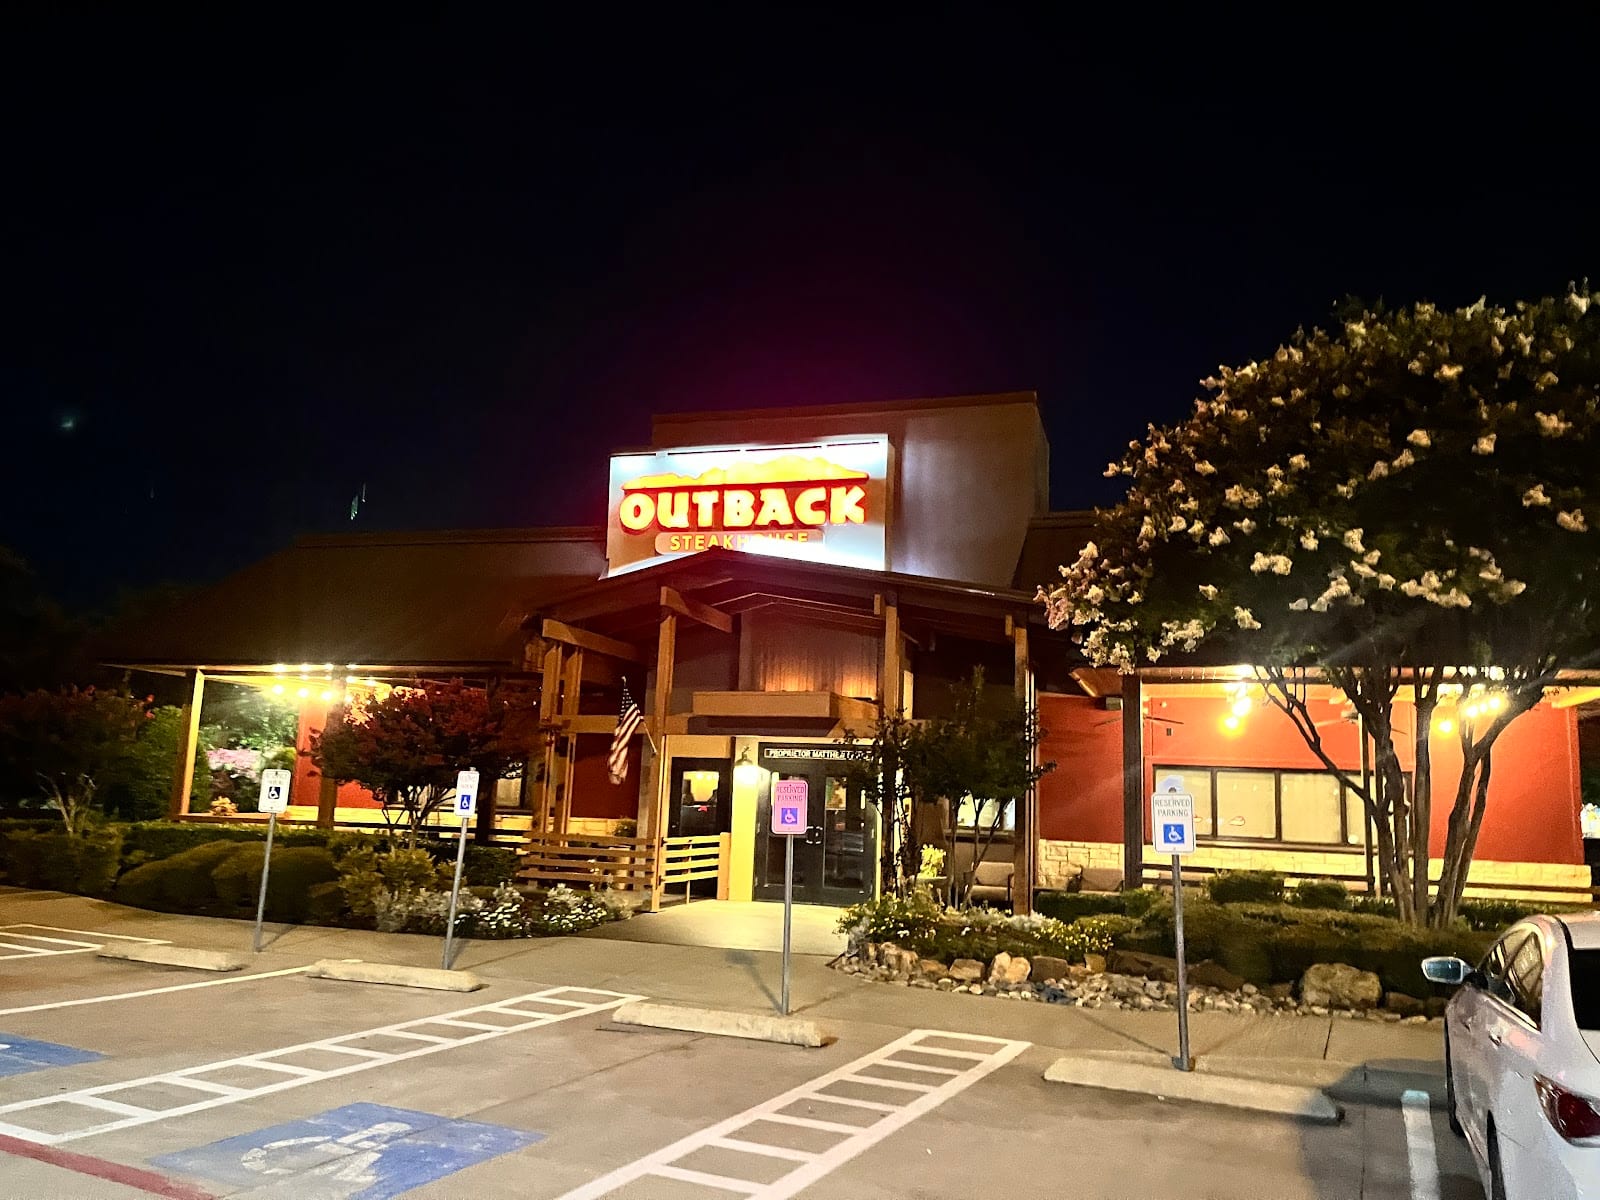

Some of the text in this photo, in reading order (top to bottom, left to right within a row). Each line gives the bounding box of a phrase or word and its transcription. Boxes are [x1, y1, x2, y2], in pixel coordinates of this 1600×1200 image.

[619, 486, 866, 531] OUTBACK
[669, 532, 809, 551] STEAKHUSE
[769, 749, 810, 759] PROPRIETOR
[776, 786, 805, 794] RESERVED
[1154, 799, 1190, 808] RESERVED
[1157, 808, 1189, 817] PARKING
